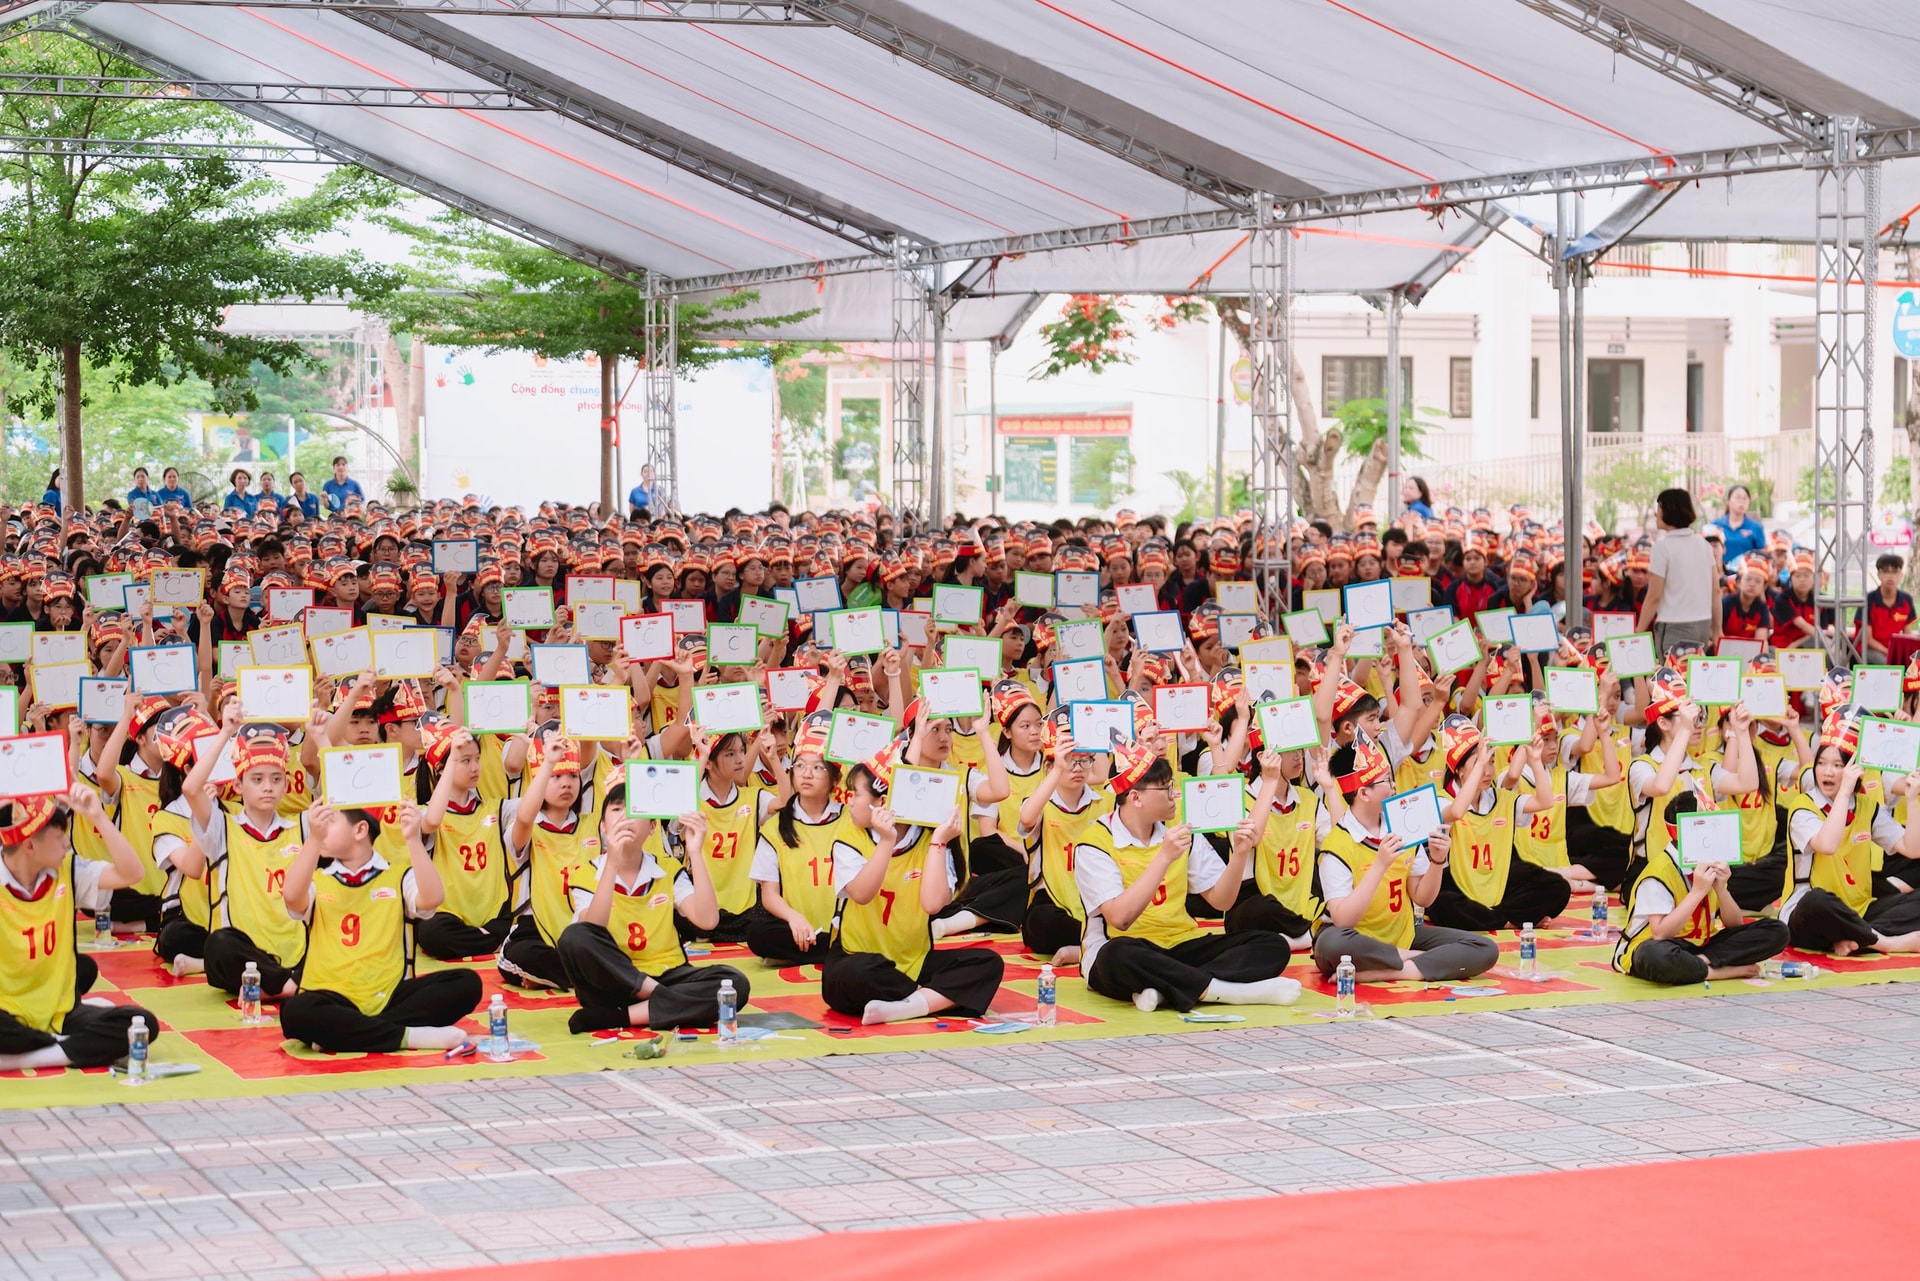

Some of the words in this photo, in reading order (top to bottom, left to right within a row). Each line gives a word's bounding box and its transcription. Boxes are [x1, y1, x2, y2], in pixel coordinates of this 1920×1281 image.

[165, 577, 181, 595] C
[728, 635, 740, 650] C
[1072, 630, 1086, 648] C
[1076, 675, 1086, 692] C
[854, 729, 870, 750] C
[352, 766, 372, 790] C
[1204, 795, 1221, 818] C
[1403, 807, 1421, 833] C
[459, 841, 488, 871] 28
[711, 832, 739, 859] 27
[1471, 843, 1494, 871] 14
[808, 856, 834, 887] 17
[1277, 847, 1301, 878] 15
[880, 888, 896, 927] 7
[1388, 878, 1403, 914] 5
[22, 920, 57, 960] 10
[340, 913, 361, 947] 9
[627, 922, 648, 951] 8
